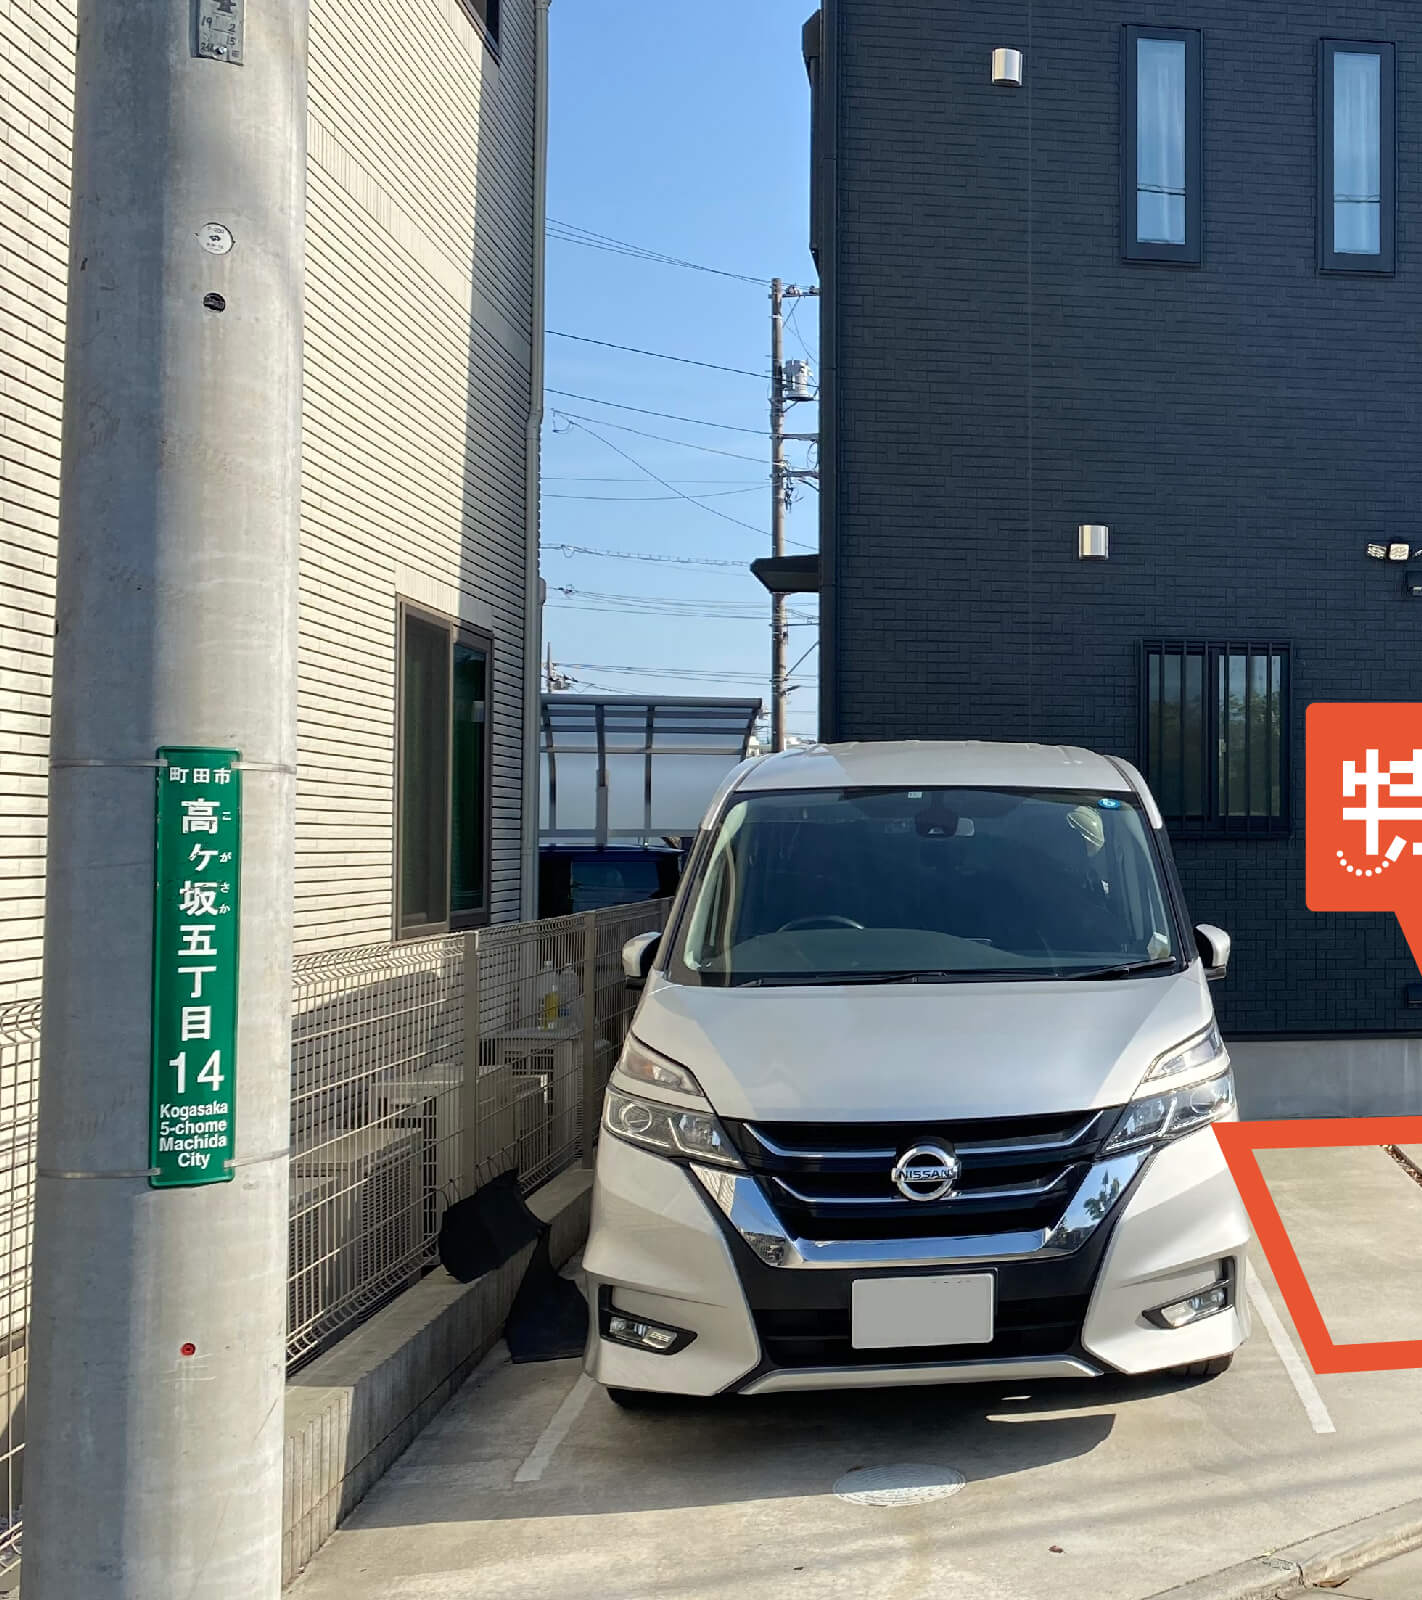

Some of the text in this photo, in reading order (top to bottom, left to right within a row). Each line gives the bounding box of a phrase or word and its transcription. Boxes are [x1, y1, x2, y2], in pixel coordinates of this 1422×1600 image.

[169, 767, 232, 784] 町田市
[169, 1050, 225, 1093] 14
[160, 1100, 229, 1120] Kogasaka
[160, 1120, 228, 1135] 5-chome
[159, 1133, 228, 1151] Machida
[178, 1152, 210, 1169] City
[898, 1169, 951, 1179] NISSAN
